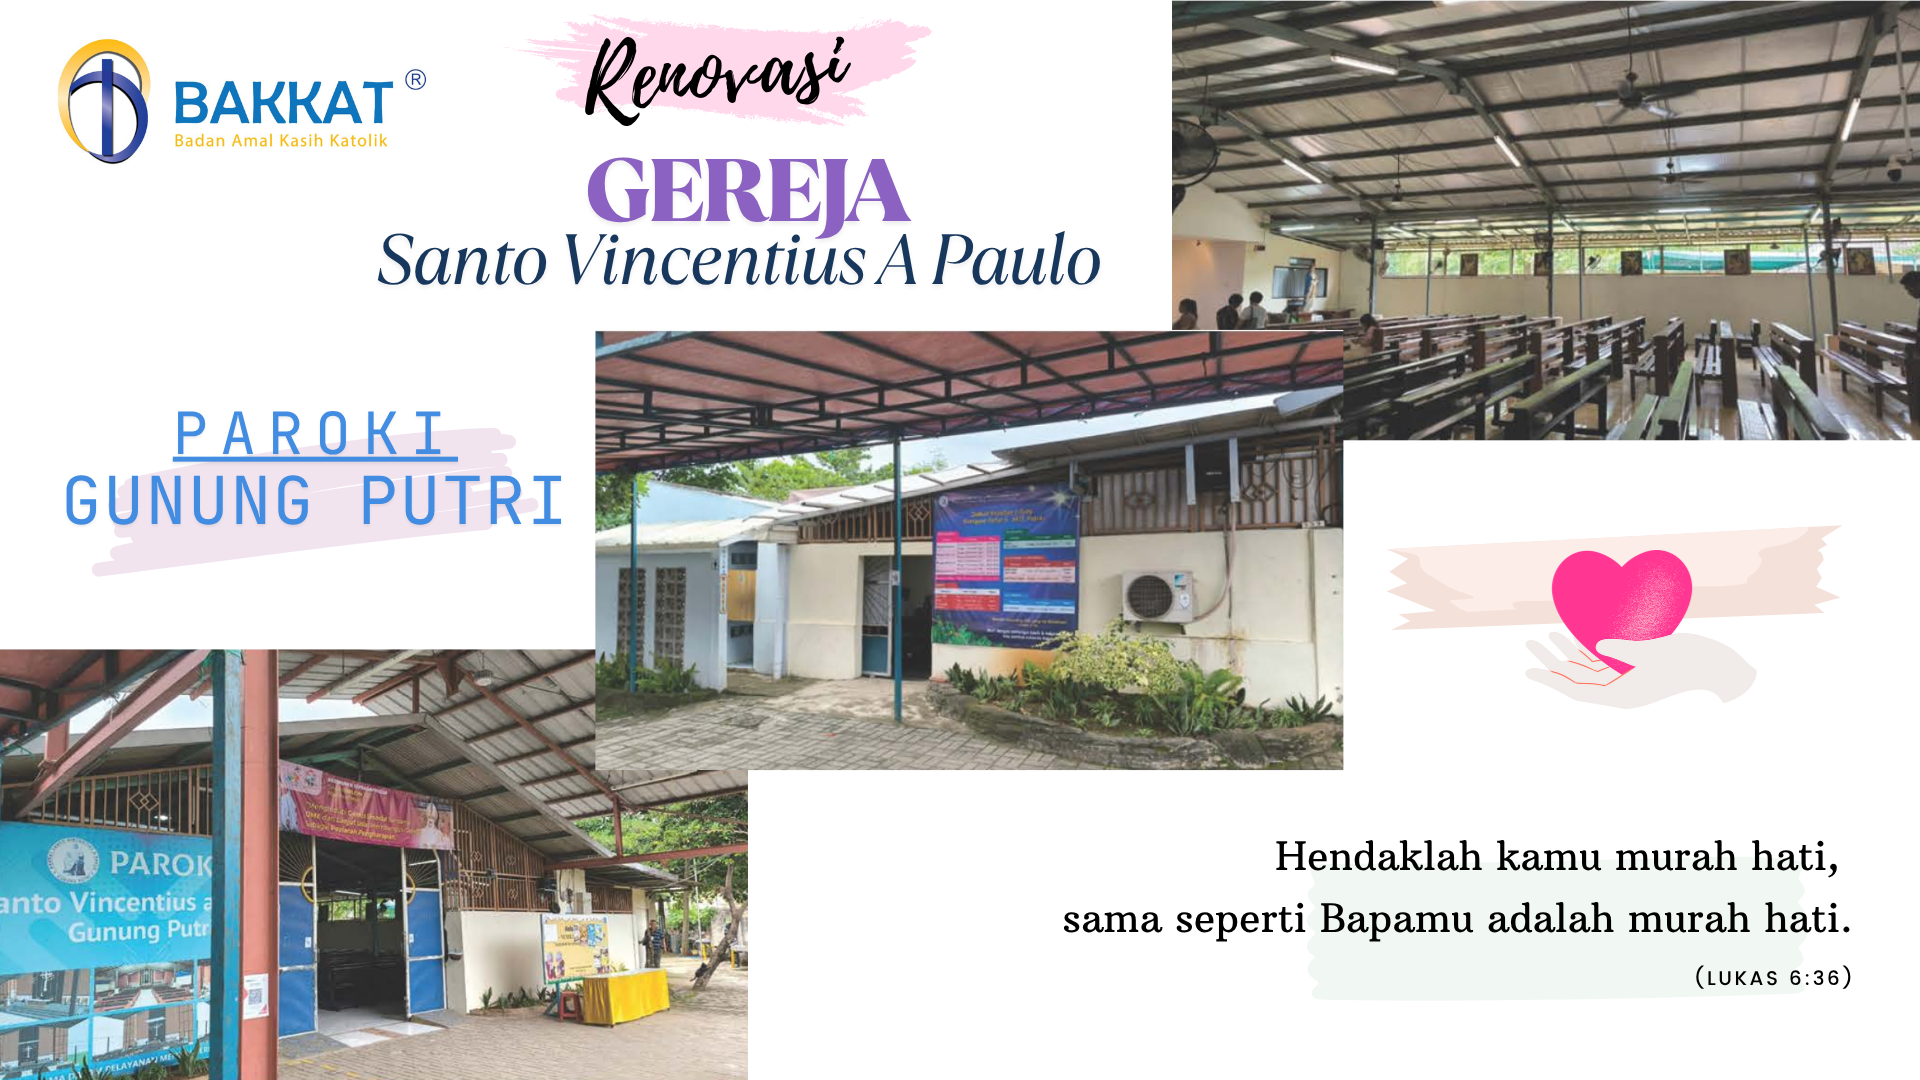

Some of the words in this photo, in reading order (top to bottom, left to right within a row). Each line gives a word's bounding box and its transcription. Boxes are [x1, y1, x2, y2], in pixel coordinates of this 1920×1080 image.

[111, 850, 212, 878] PAROK
[0, 893, 61, 914] anto
[69, 891, 196, 914] Vincentius
[68, 921, 160, 945] Gunung
[168, 919, 210, 938] Putr
